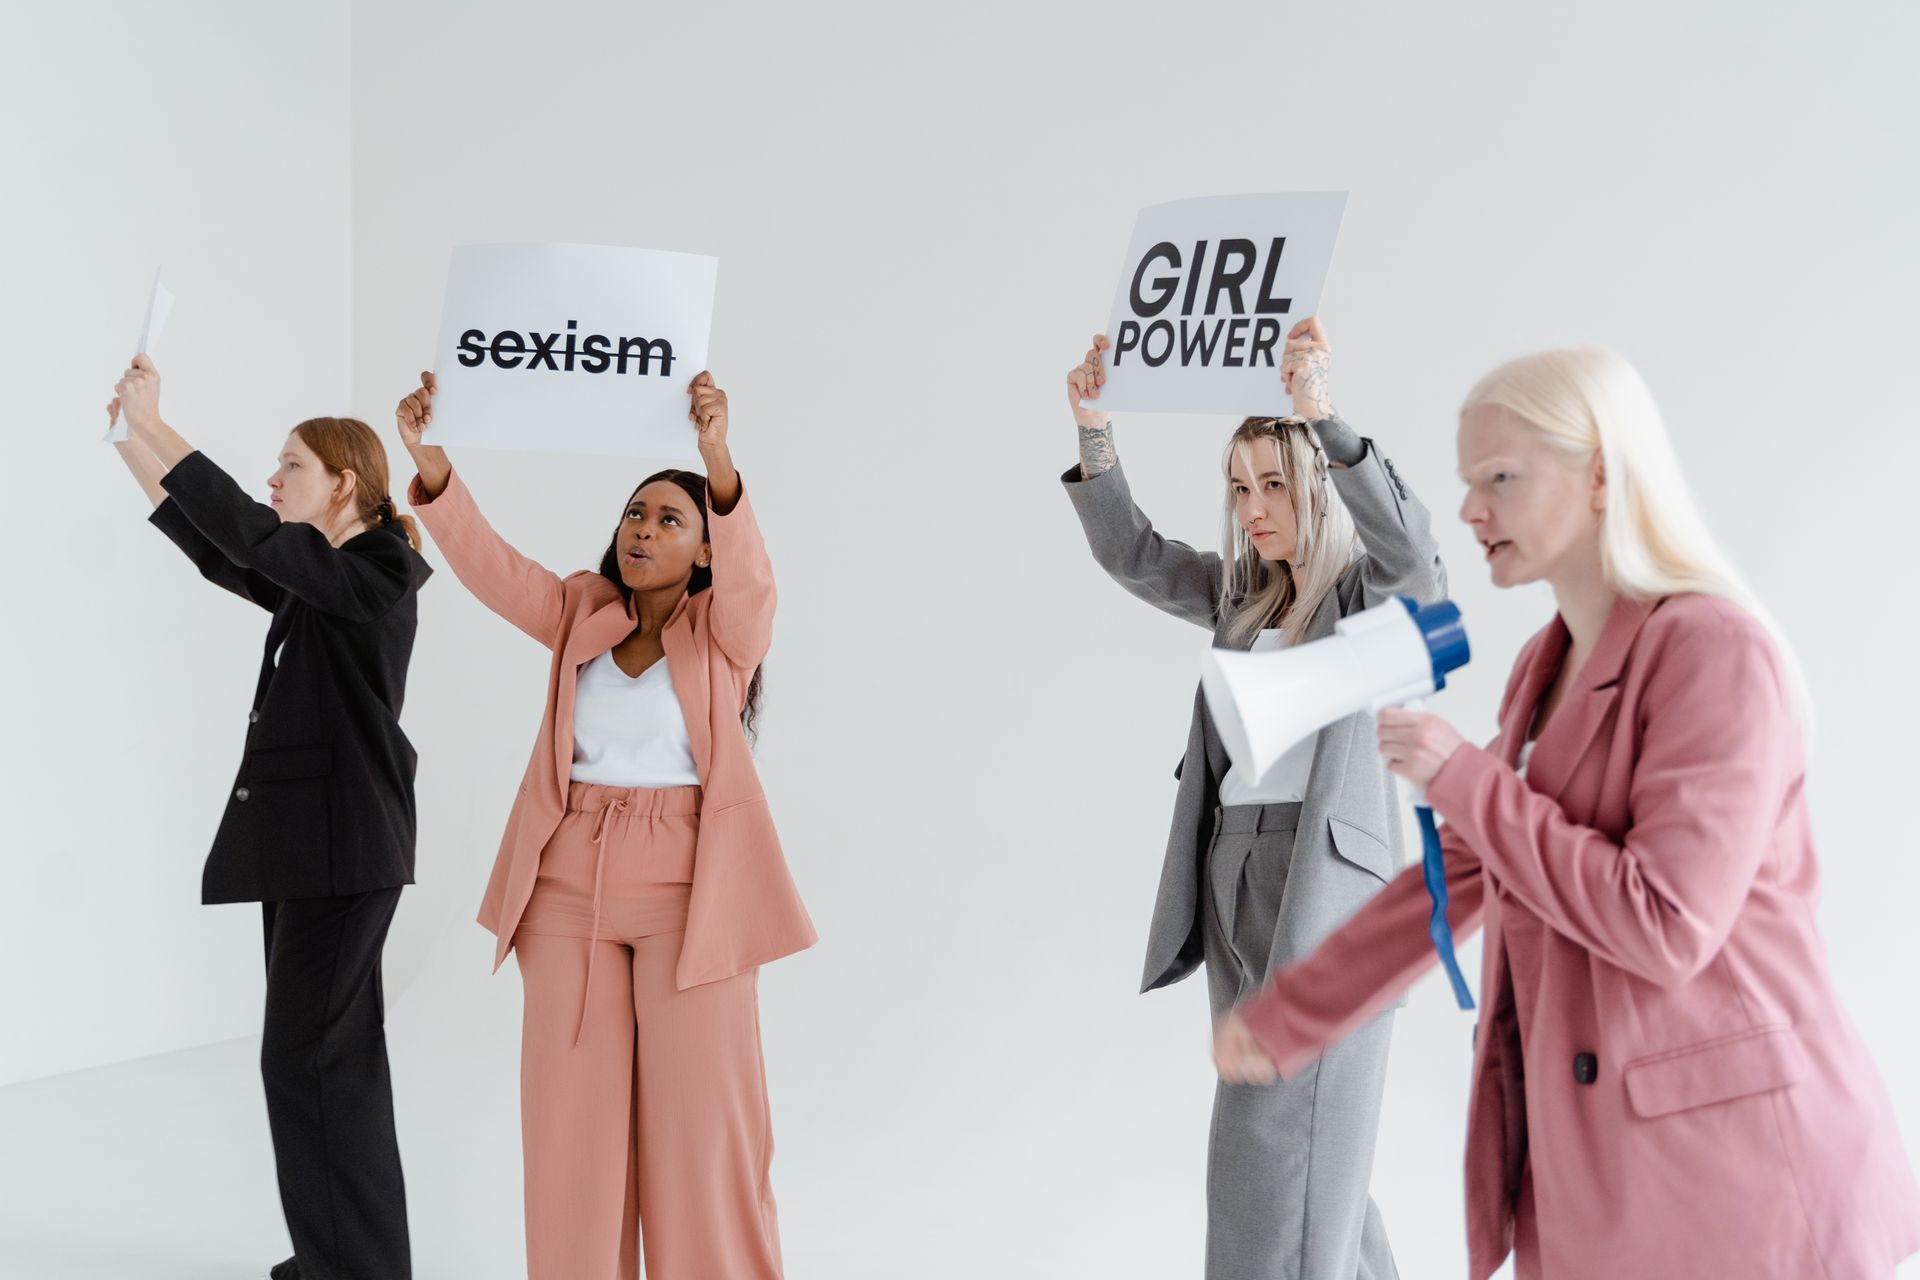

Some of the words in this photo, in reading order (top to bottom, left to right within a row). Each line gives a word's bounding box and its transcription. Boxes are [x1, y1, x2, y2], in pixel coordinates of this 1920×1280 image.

[1129, 236, 1293, 318] GIRL
[456, 319, 677, 377] sexism
[1113, 318, 1281, 368] POWER
